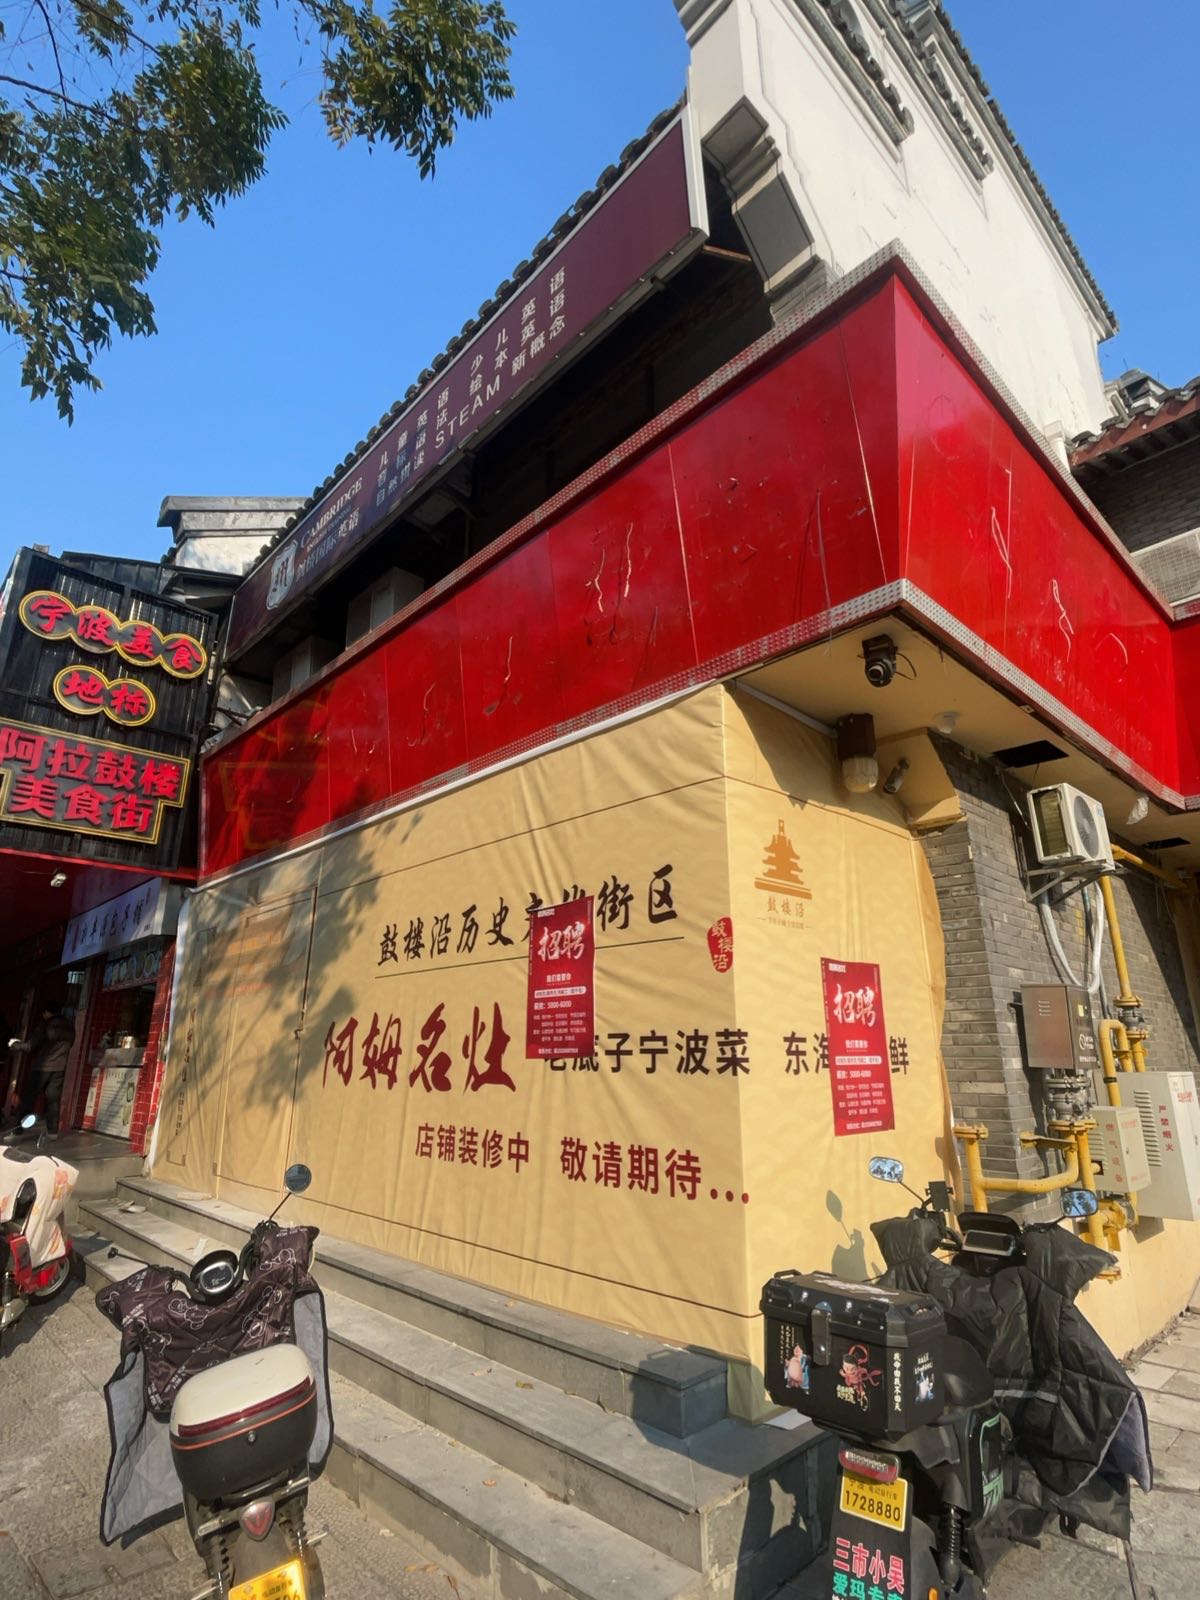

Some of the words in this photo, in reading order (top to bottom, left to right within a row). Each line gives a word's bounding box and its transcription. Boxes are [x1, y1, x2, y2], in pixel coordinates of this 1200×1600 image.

[435, 375, 501, 449] STEAM
[30, 594, 203, 671] 宁波美食
[62, 670, 149, 716] 地标
[0, 727, 182, 799] 阿拉鼓楼
[9, 774, 153, 832] 美食街
[537, 921, 586, 963] 招聘
[710, 921, 734, 970] 鼓楼沿
[833, 984, 878, 1028] 招聘
[322, 1002, 517, 1093] 阿姆名灶
[414, 1123, 530, 1174] 店铺装修中
[1158, 1105, 1175, 1152] 严禁烟火
[845, 1490, 901, 1522] 1728880
[833, 1537, 905, 1595] 三市小吴
